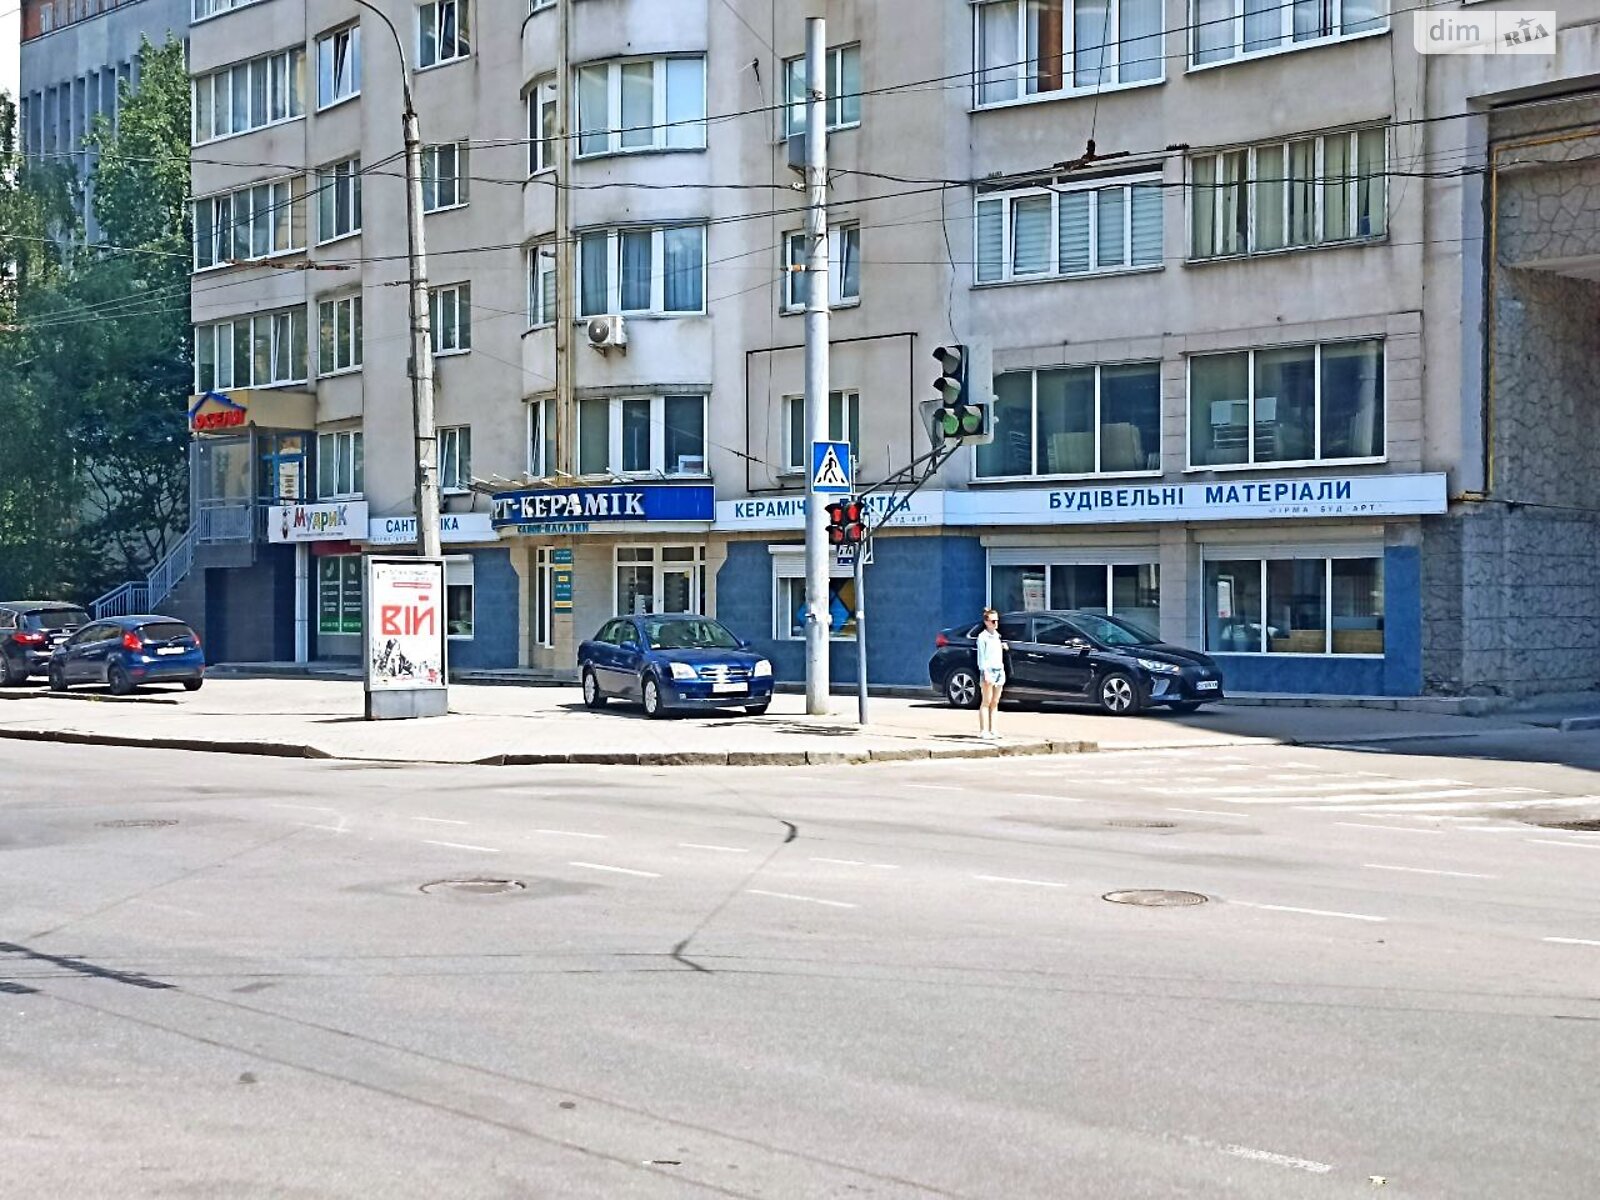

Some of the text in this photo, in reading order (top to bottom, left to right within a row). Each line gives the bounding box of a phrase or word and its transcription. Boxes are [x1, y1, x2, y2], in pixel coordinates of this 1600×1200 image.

[491, 493, 645, 520] РТ-КЕРАМІК
[735, 500, 806, 518] КЕРАМІЧ
[1049, 480, 1351, 511] БУДІВЕЛЬНІ МАТЕРІАЛИ
[386, 517, 459, 533] САНТІКА
[381, 595, 435, 636] ВІЙ
